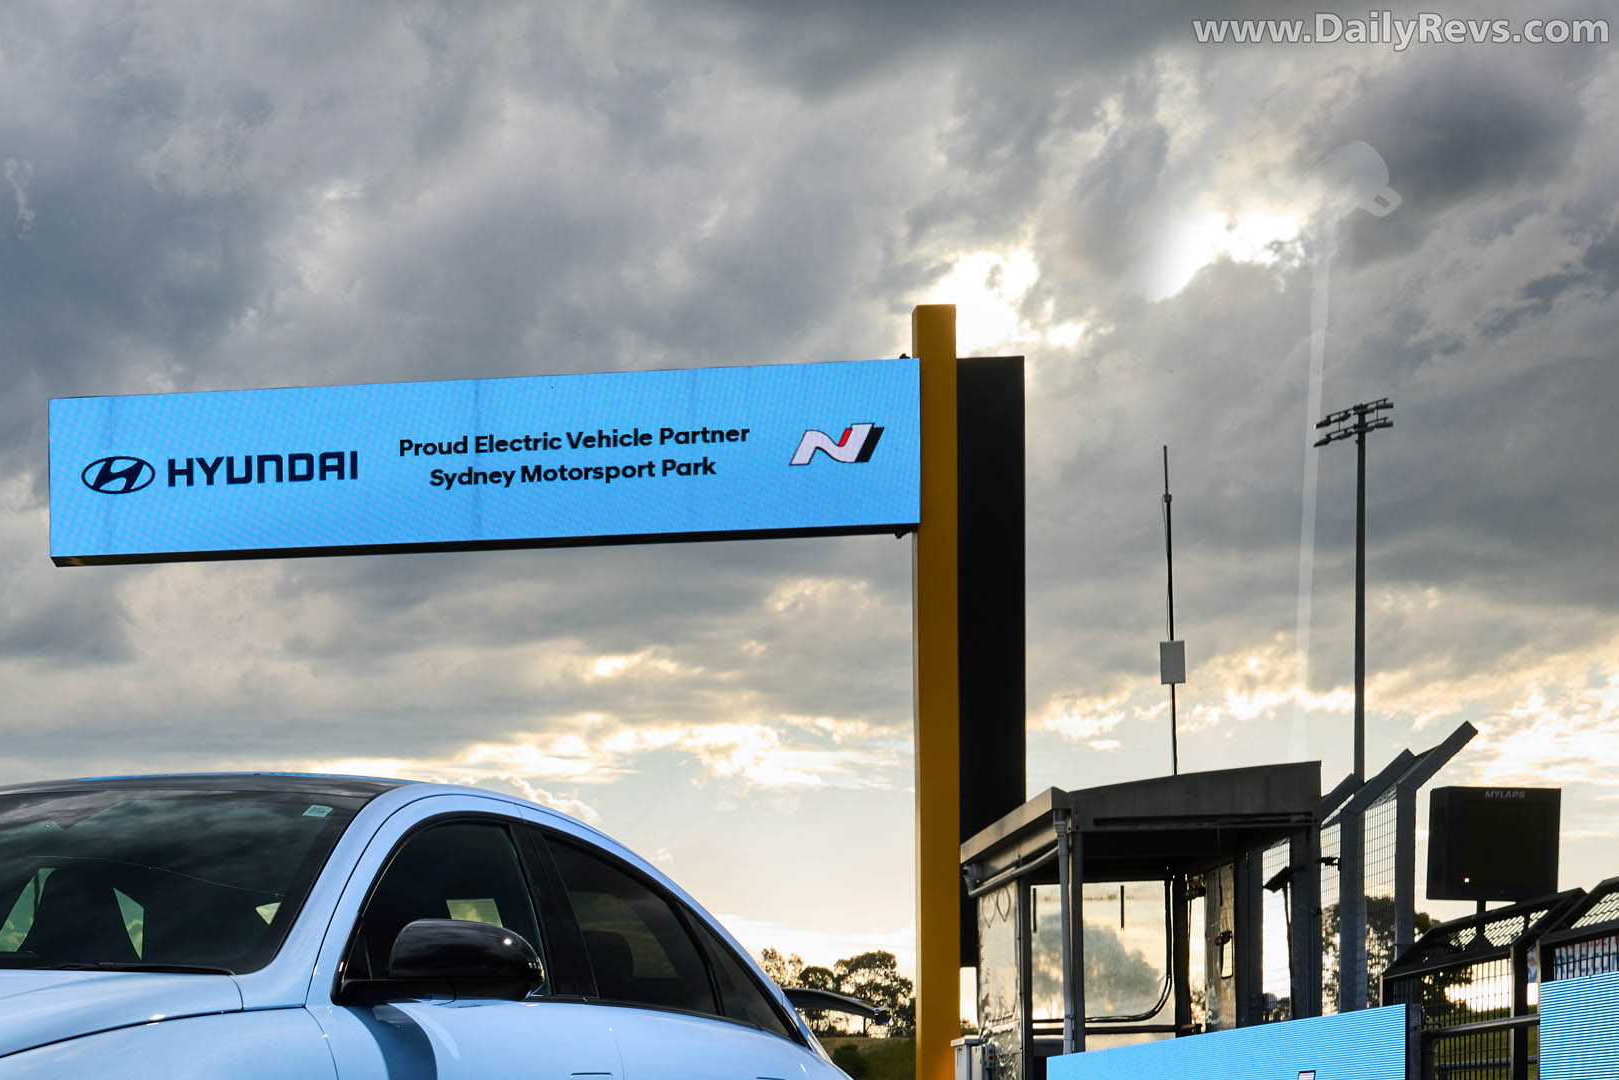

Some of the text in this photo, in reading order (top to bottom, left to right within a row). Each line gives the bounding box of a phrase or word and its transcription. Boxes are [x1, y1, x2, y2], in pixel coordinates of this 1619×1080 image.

[399, 426, 751, 457] Proud Electric Vehicle Partner
[167, 450, 358, 487] HYUNDAI
[429, 456, 717, 491] Sydney Motorsport Park
